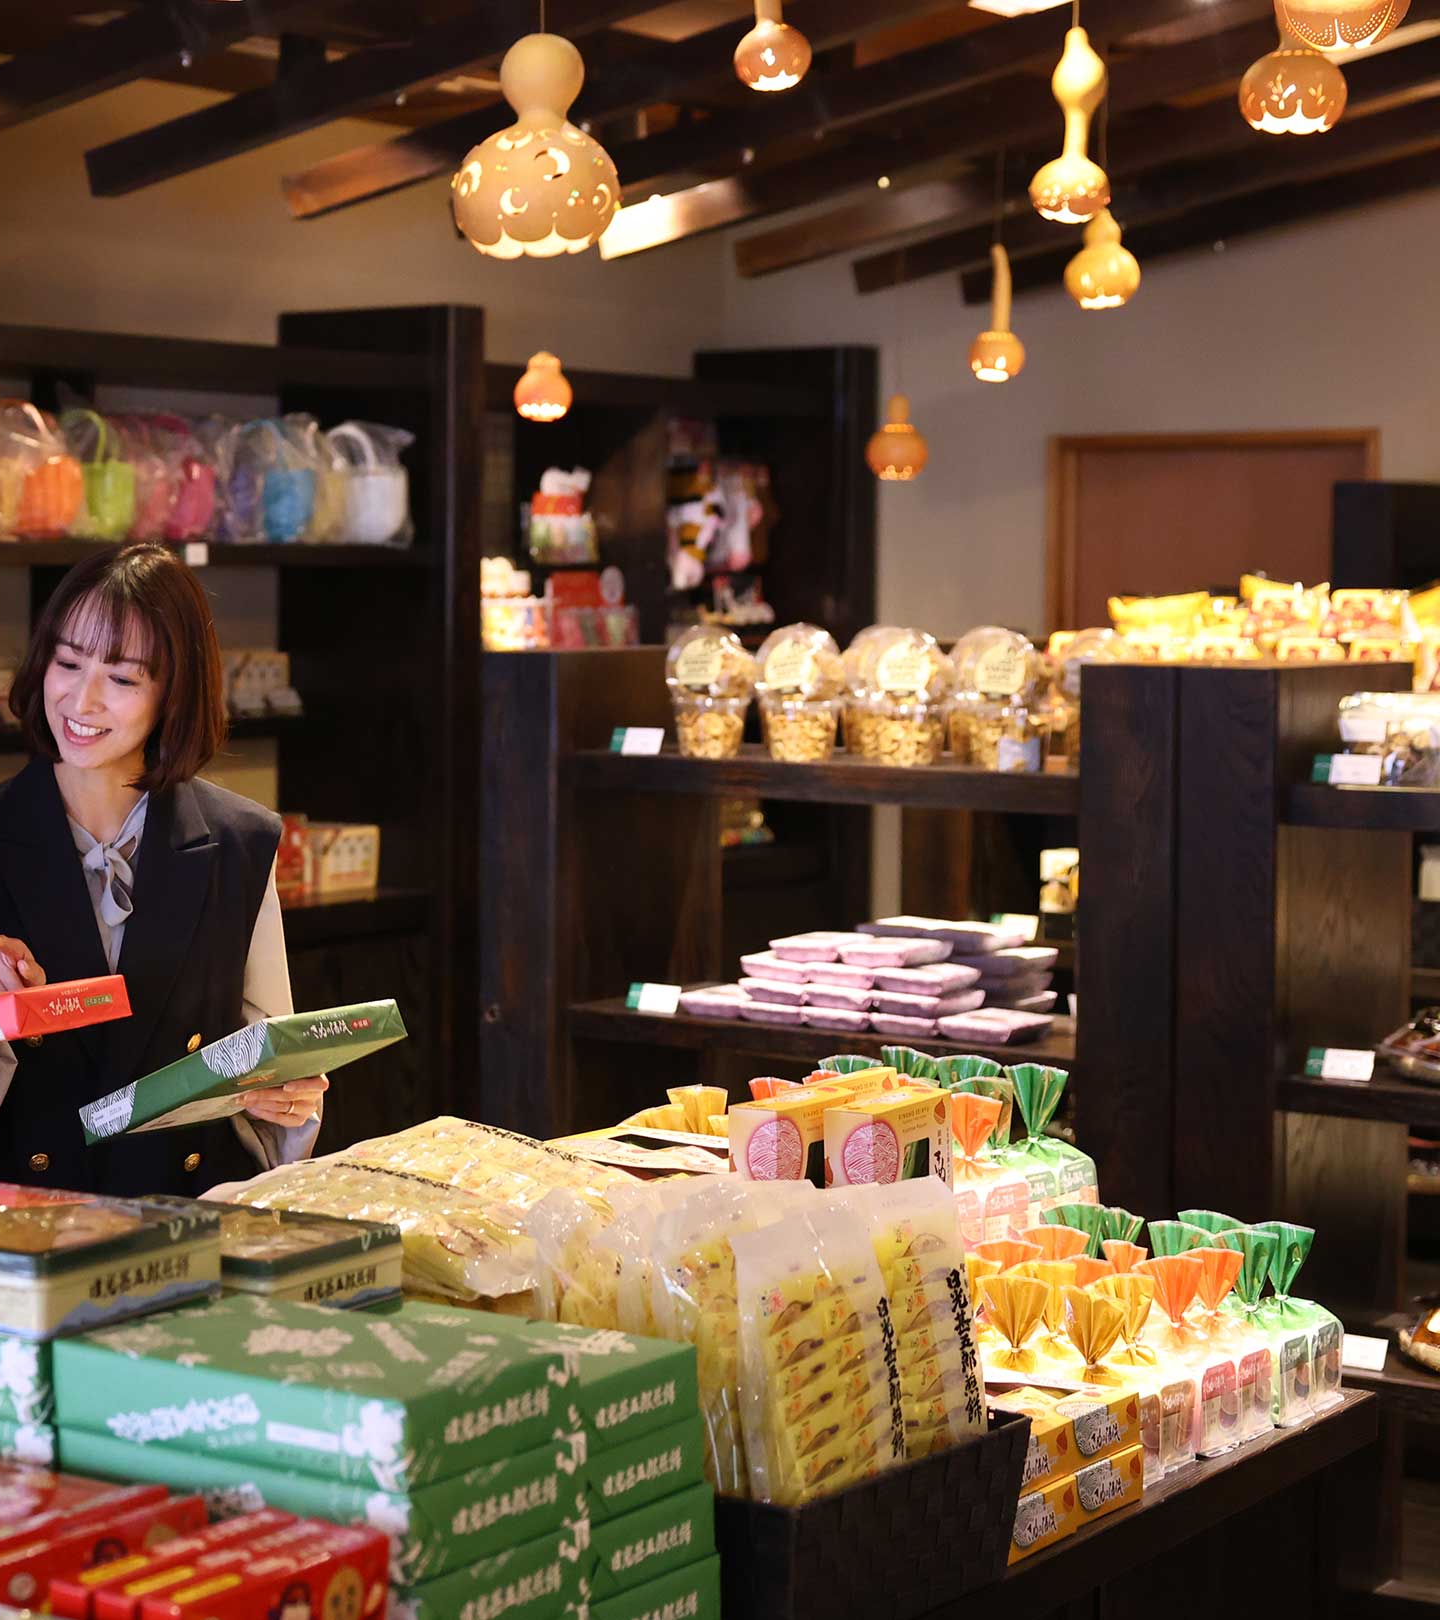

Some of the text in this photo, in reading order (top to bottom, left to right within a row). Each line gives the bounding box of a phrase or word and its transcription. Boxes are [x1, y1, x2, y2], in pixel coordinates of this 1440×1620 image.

[876, 1297, 906, 1460] 日光甚五郎煎餅
[946, 1269, 982, 1425] 日光甚五郎煎餅
